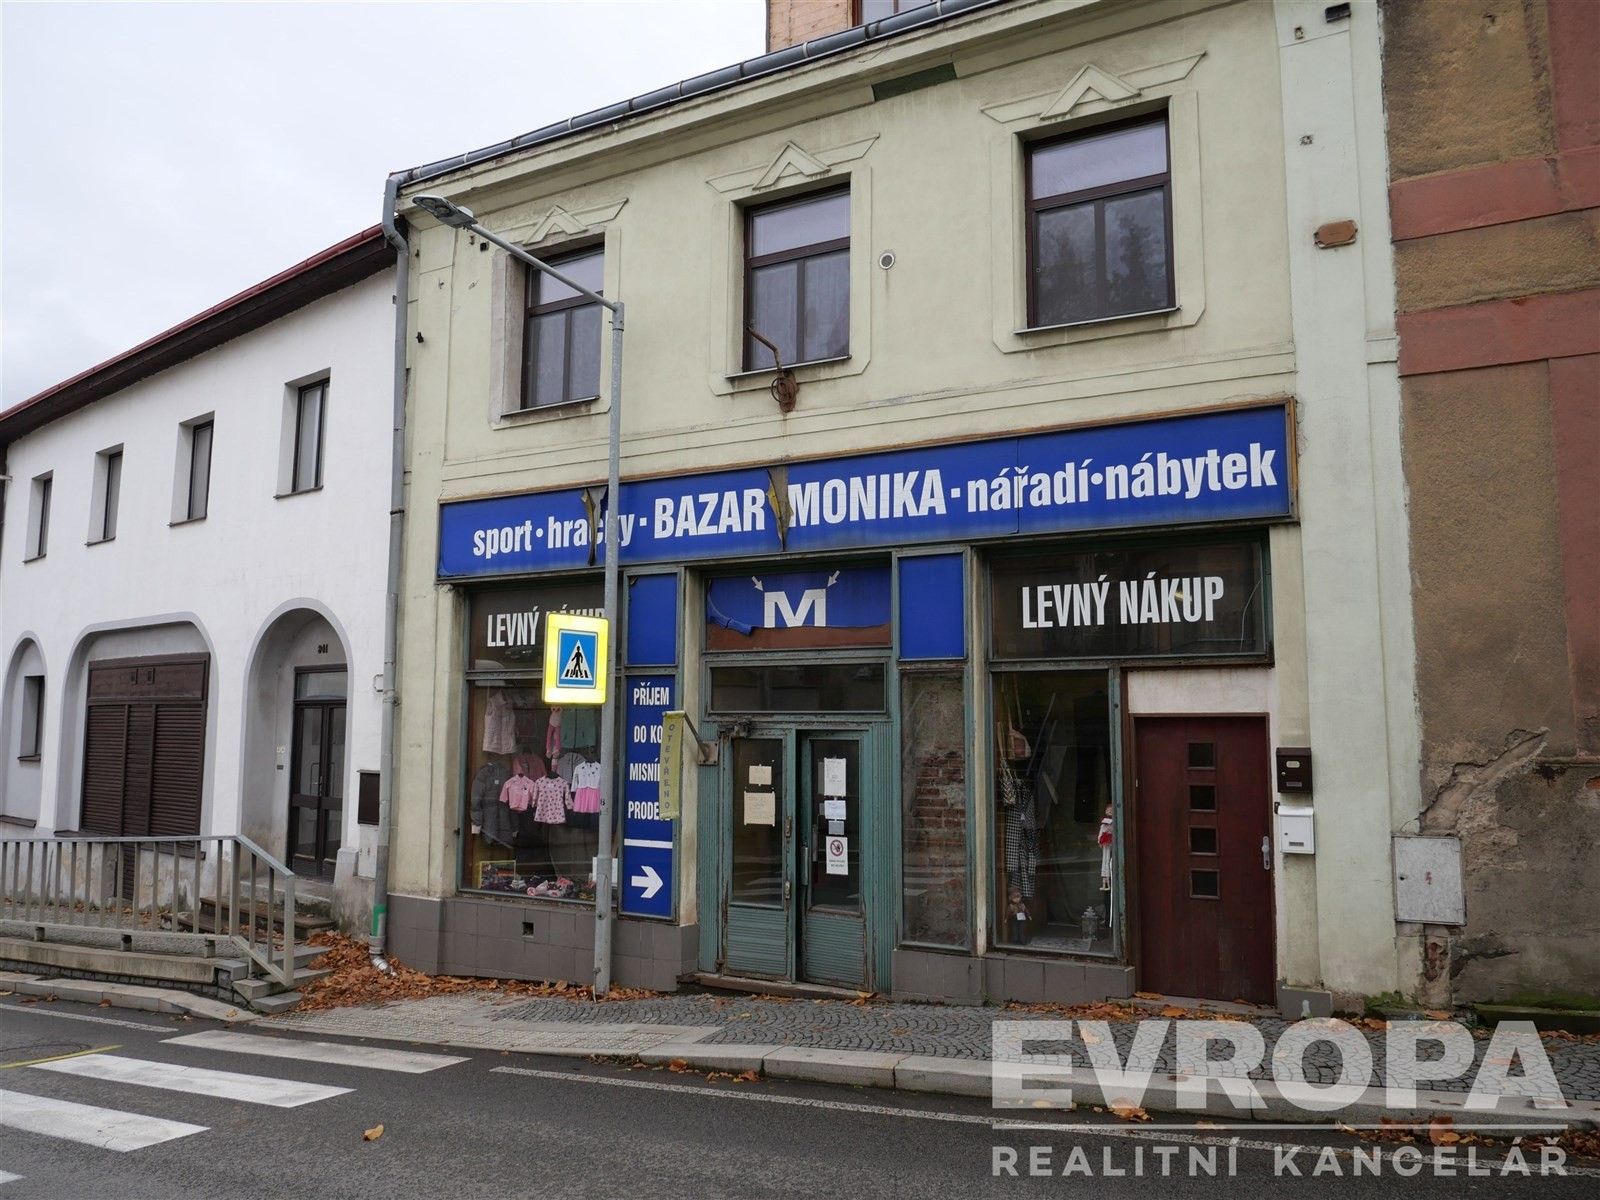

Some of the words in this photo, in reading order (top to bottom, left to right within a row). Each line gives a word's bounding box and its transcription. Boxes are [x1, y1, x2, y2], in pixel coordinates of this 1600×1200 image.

[473, 519, 532, 560] sport
[654, 488, 766, 539] BAZAR
[787, 468, 946, 528] MONIKA
[968, 458, 1091, 513] nářadí
[1106, 442, 1277, 500] nábytek
[763, 588, 827, 628] M
[1021, 574, 1111, 629] LEVNÝ
[1119, 570, 1224, 624] NÁKUP
[487, 605, 539, 647] LEVNÝ
[633, 682, 670, 706] PŘÍJEM
[633, 725, 647, 743] DO
